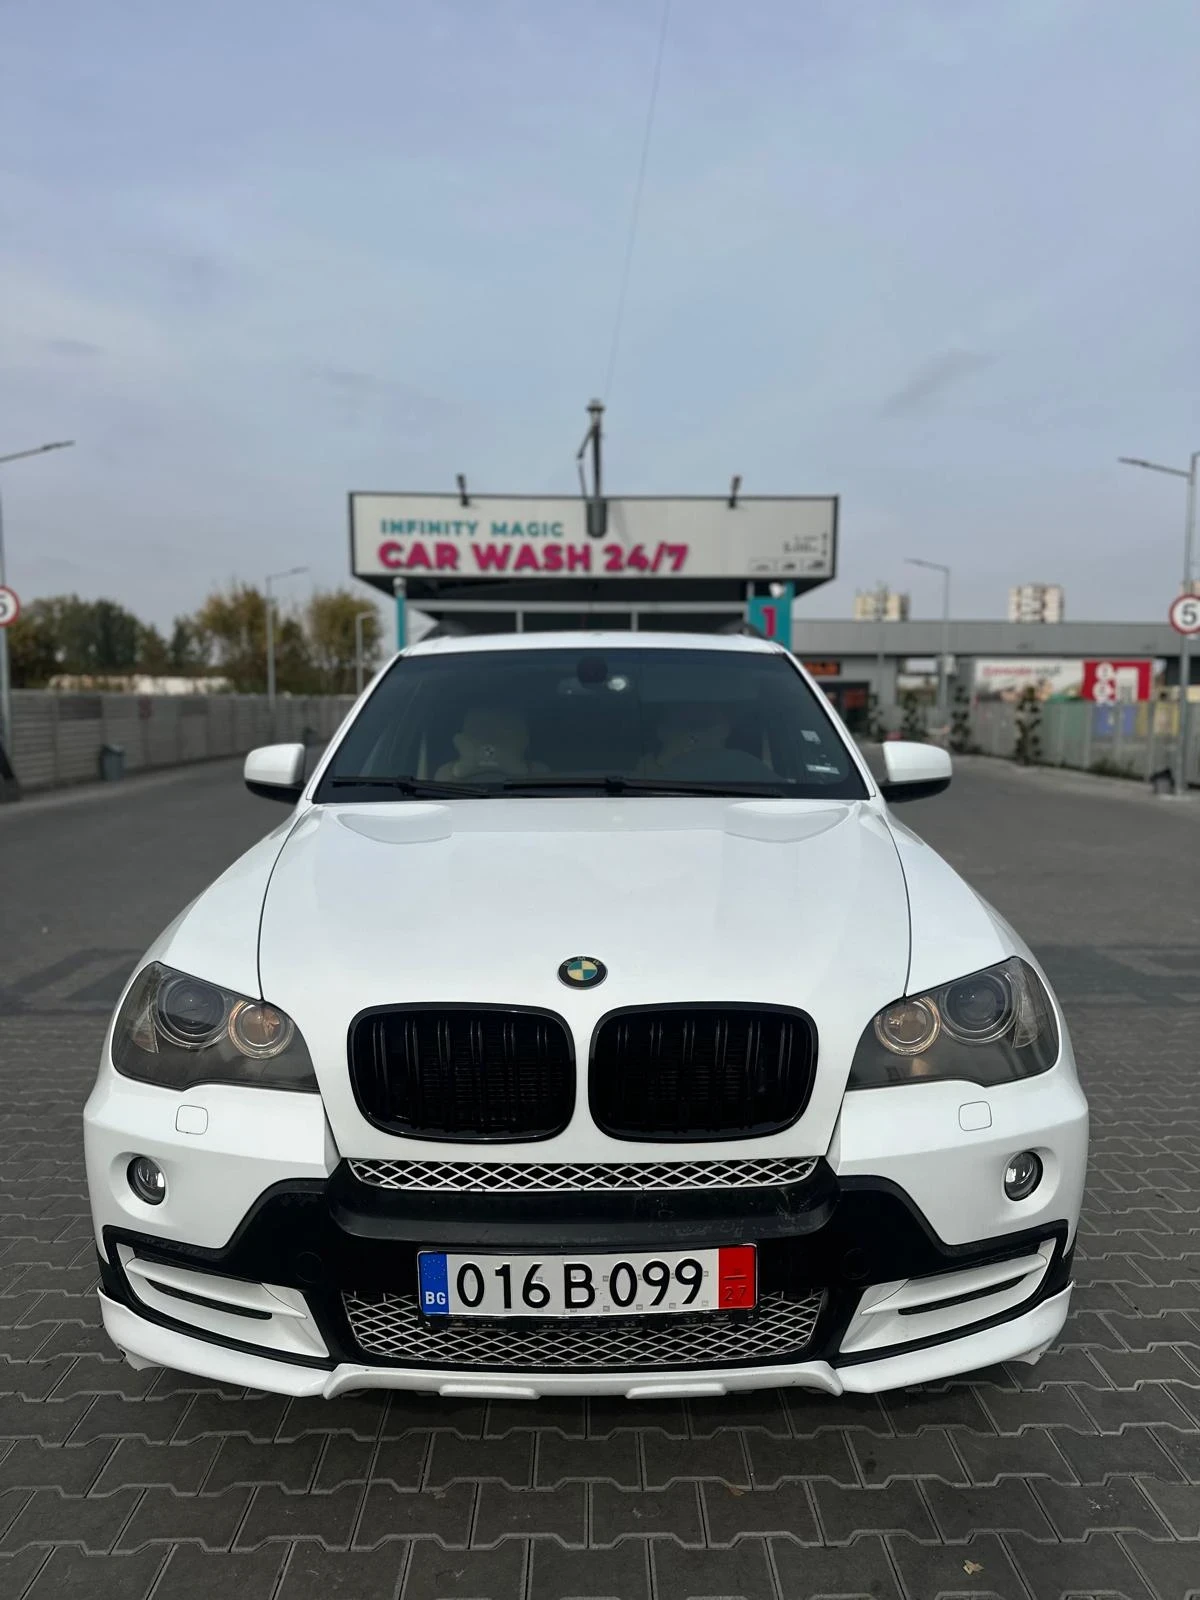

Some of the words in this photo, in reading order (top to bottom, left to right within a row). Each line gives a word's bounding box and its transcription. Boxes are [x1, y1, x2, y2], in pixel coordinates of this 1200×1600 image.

[380, 519, 479, 537] INFINITY
[490, 521, 565, 538] MAGIC
[378, 540, 461, 570] CAR
[470, 542, 592, 572] WASH
[602, 541, 689, 573] 24/7
[762, 605, 777, 638] 1
[1182, 602, 1197, 626] 5
[425, 1291, 447, 1305] BG
